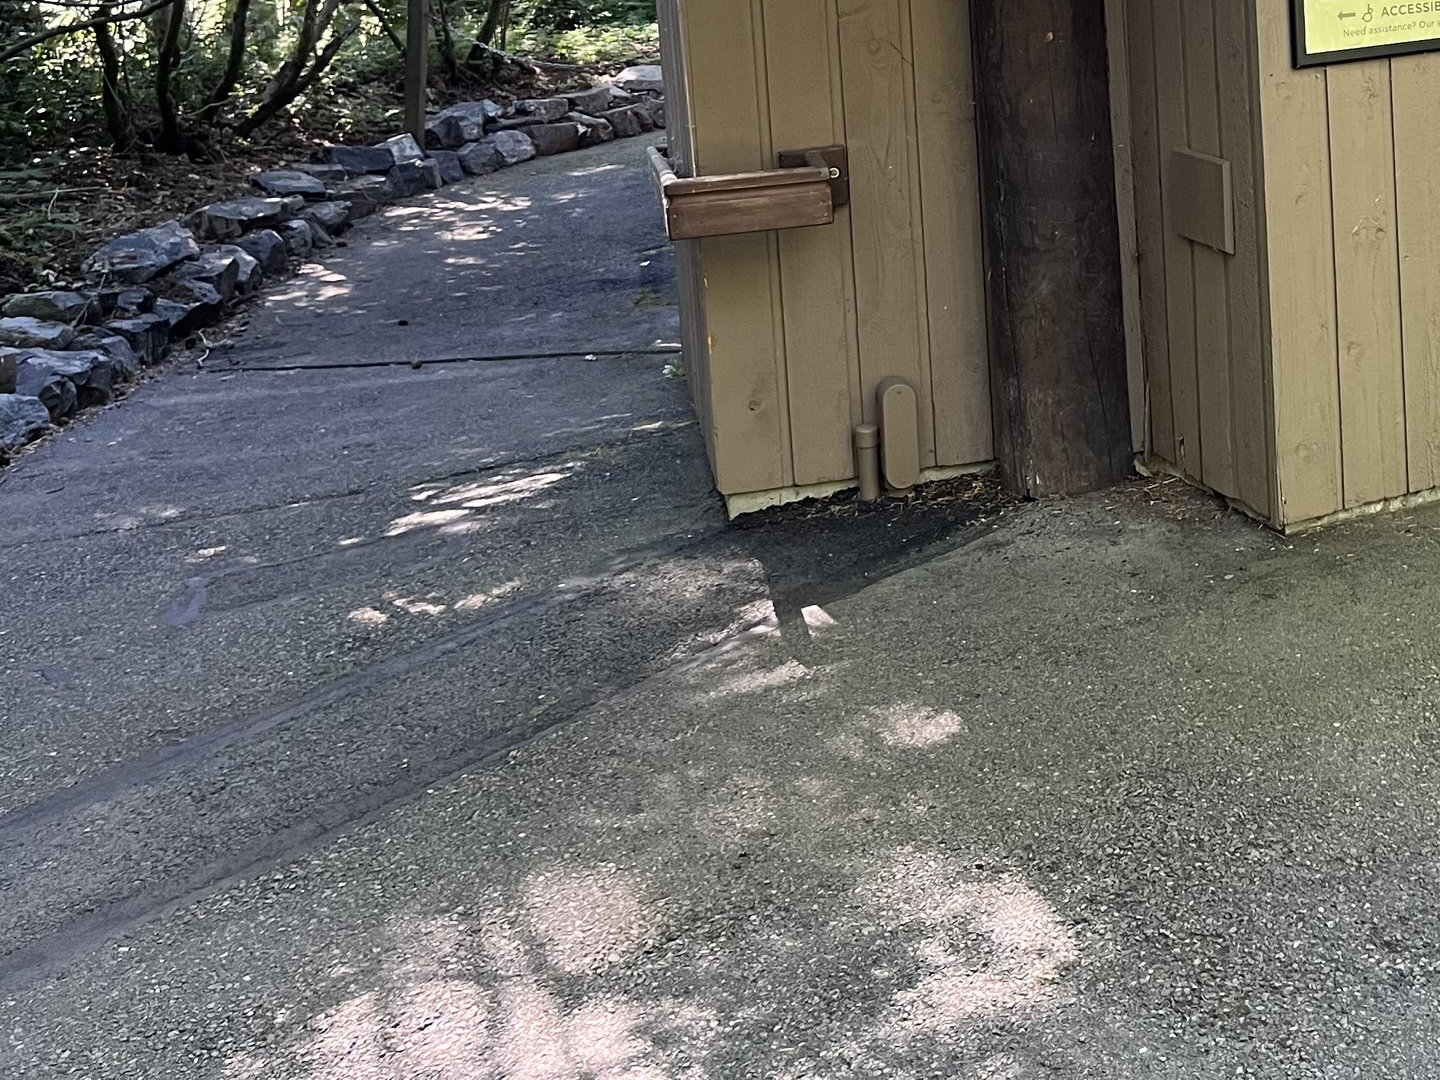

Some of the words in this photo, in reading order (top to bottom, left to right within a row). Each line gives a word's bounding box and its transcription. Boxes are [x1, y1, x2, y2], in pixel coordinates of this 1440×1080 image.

[1343, 26, 1367, 37] Need
[1368, 21, 1417, 35] assistance?
[1419, 19, 1435, 29] Our
